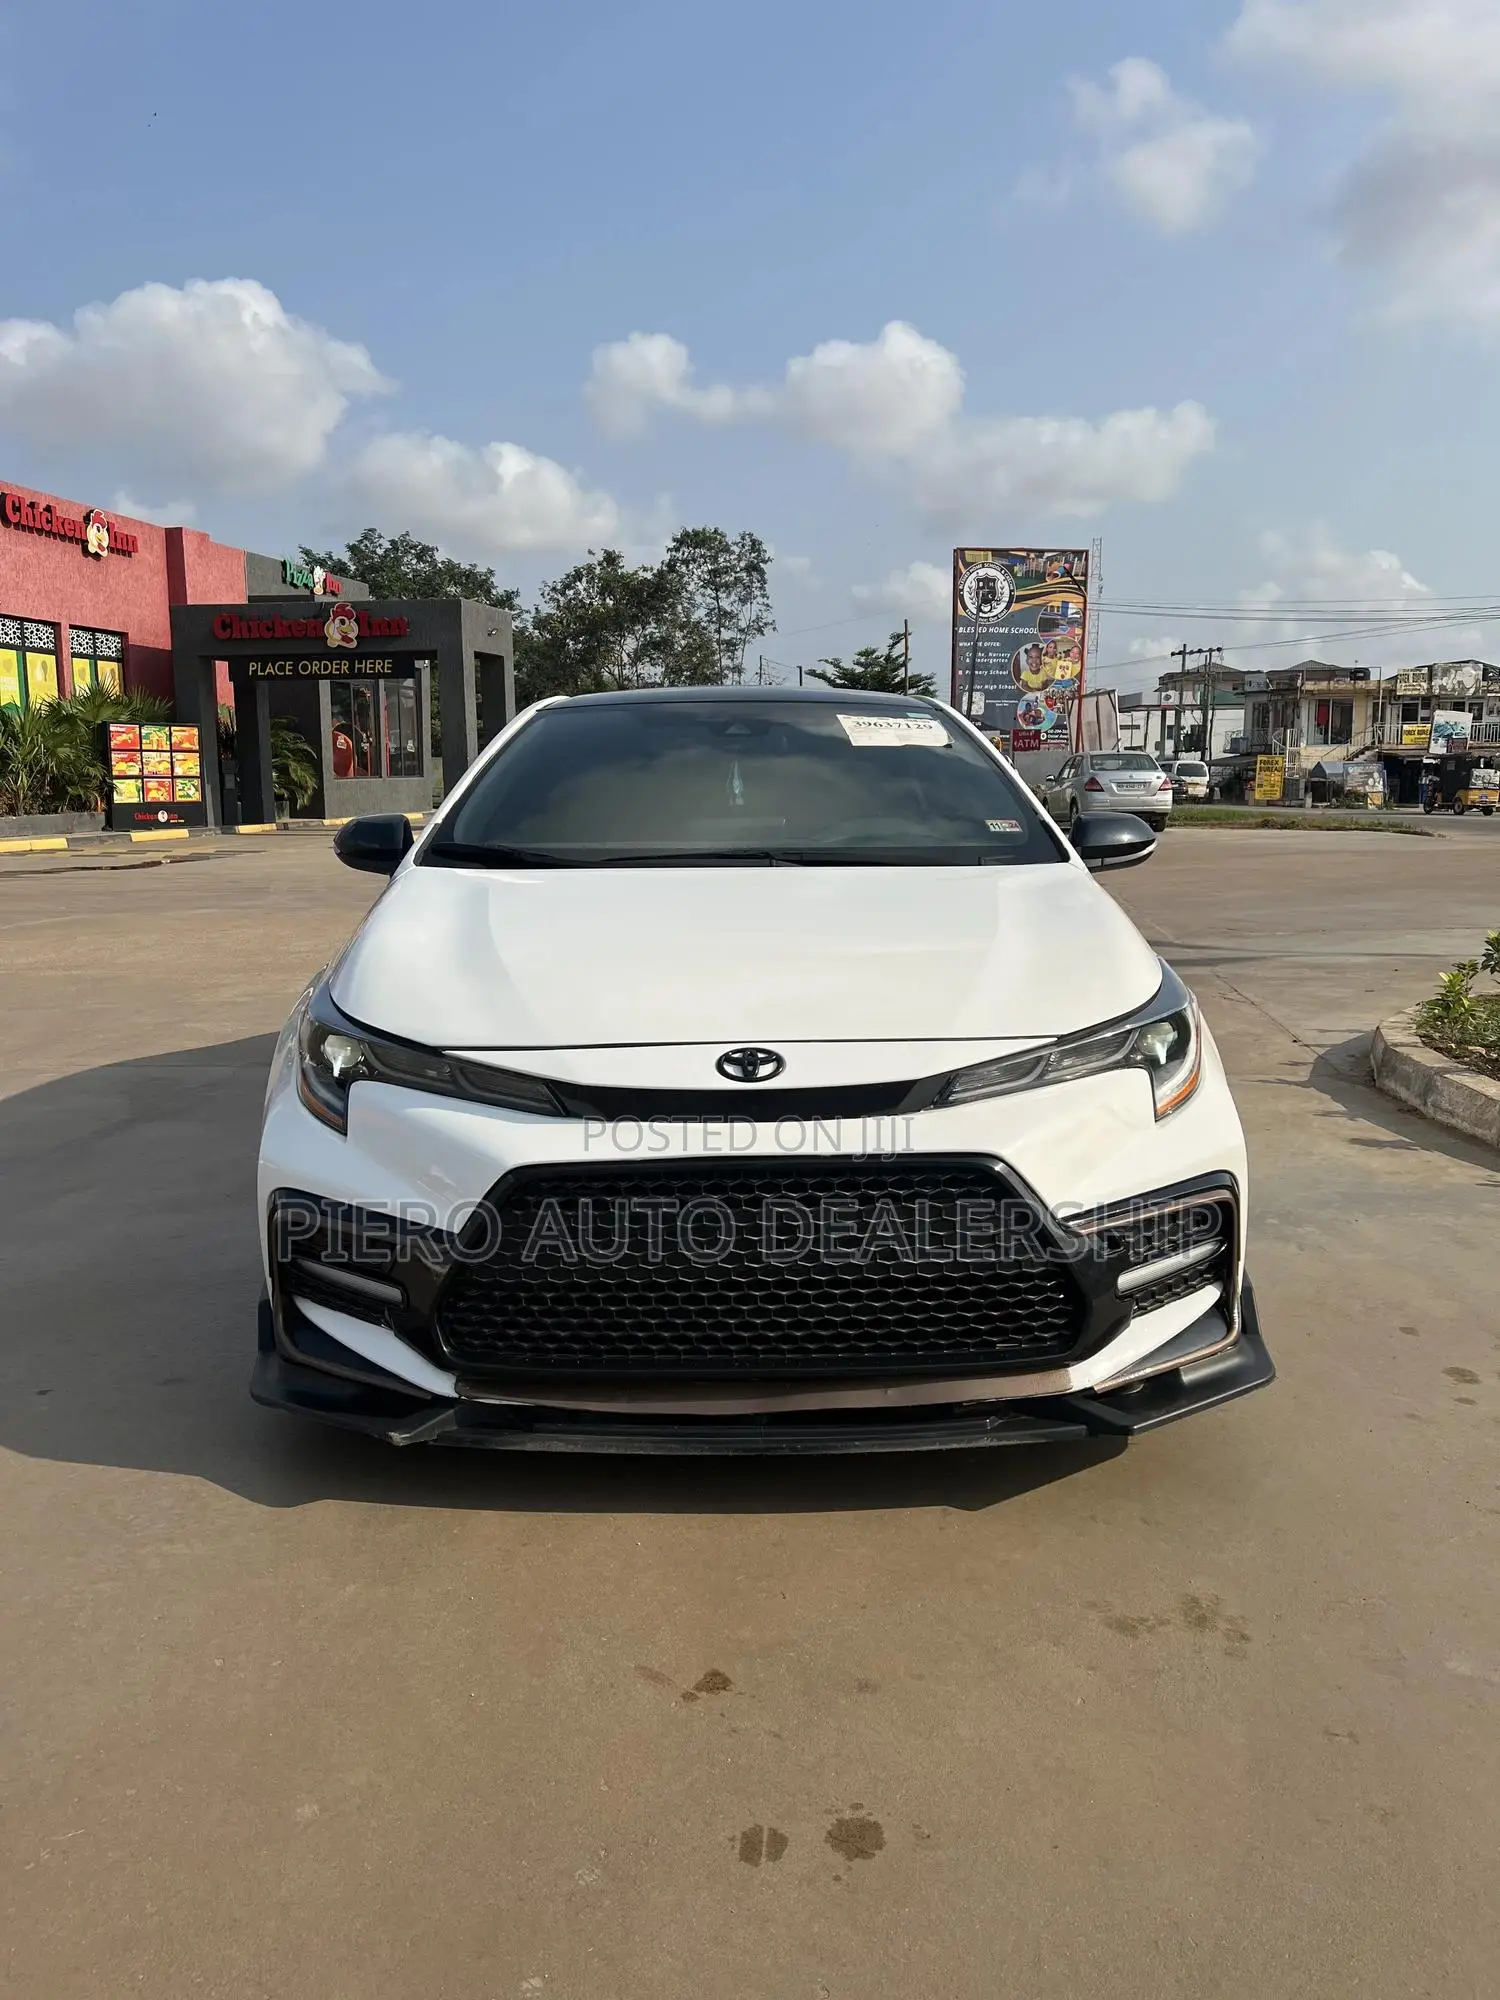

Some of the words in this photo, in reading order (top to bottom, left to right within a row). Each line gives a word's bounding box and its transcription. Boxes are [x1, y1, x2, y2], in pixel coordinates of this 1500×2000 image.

[5, 492, 88, 541] Chicken
[108, 521, 139, 554] Inn
[285, 557, 314, 589] Pizza
[213, 612, 324, 640] Chicken
[358, 610, 408, 637] Inn
[249, 661, 293, 676] PLACE
[298, 660, 350, 675] ORDER
[355, 659, 392, 674] HERE
[1017, 739, 1039, 748] ATM
